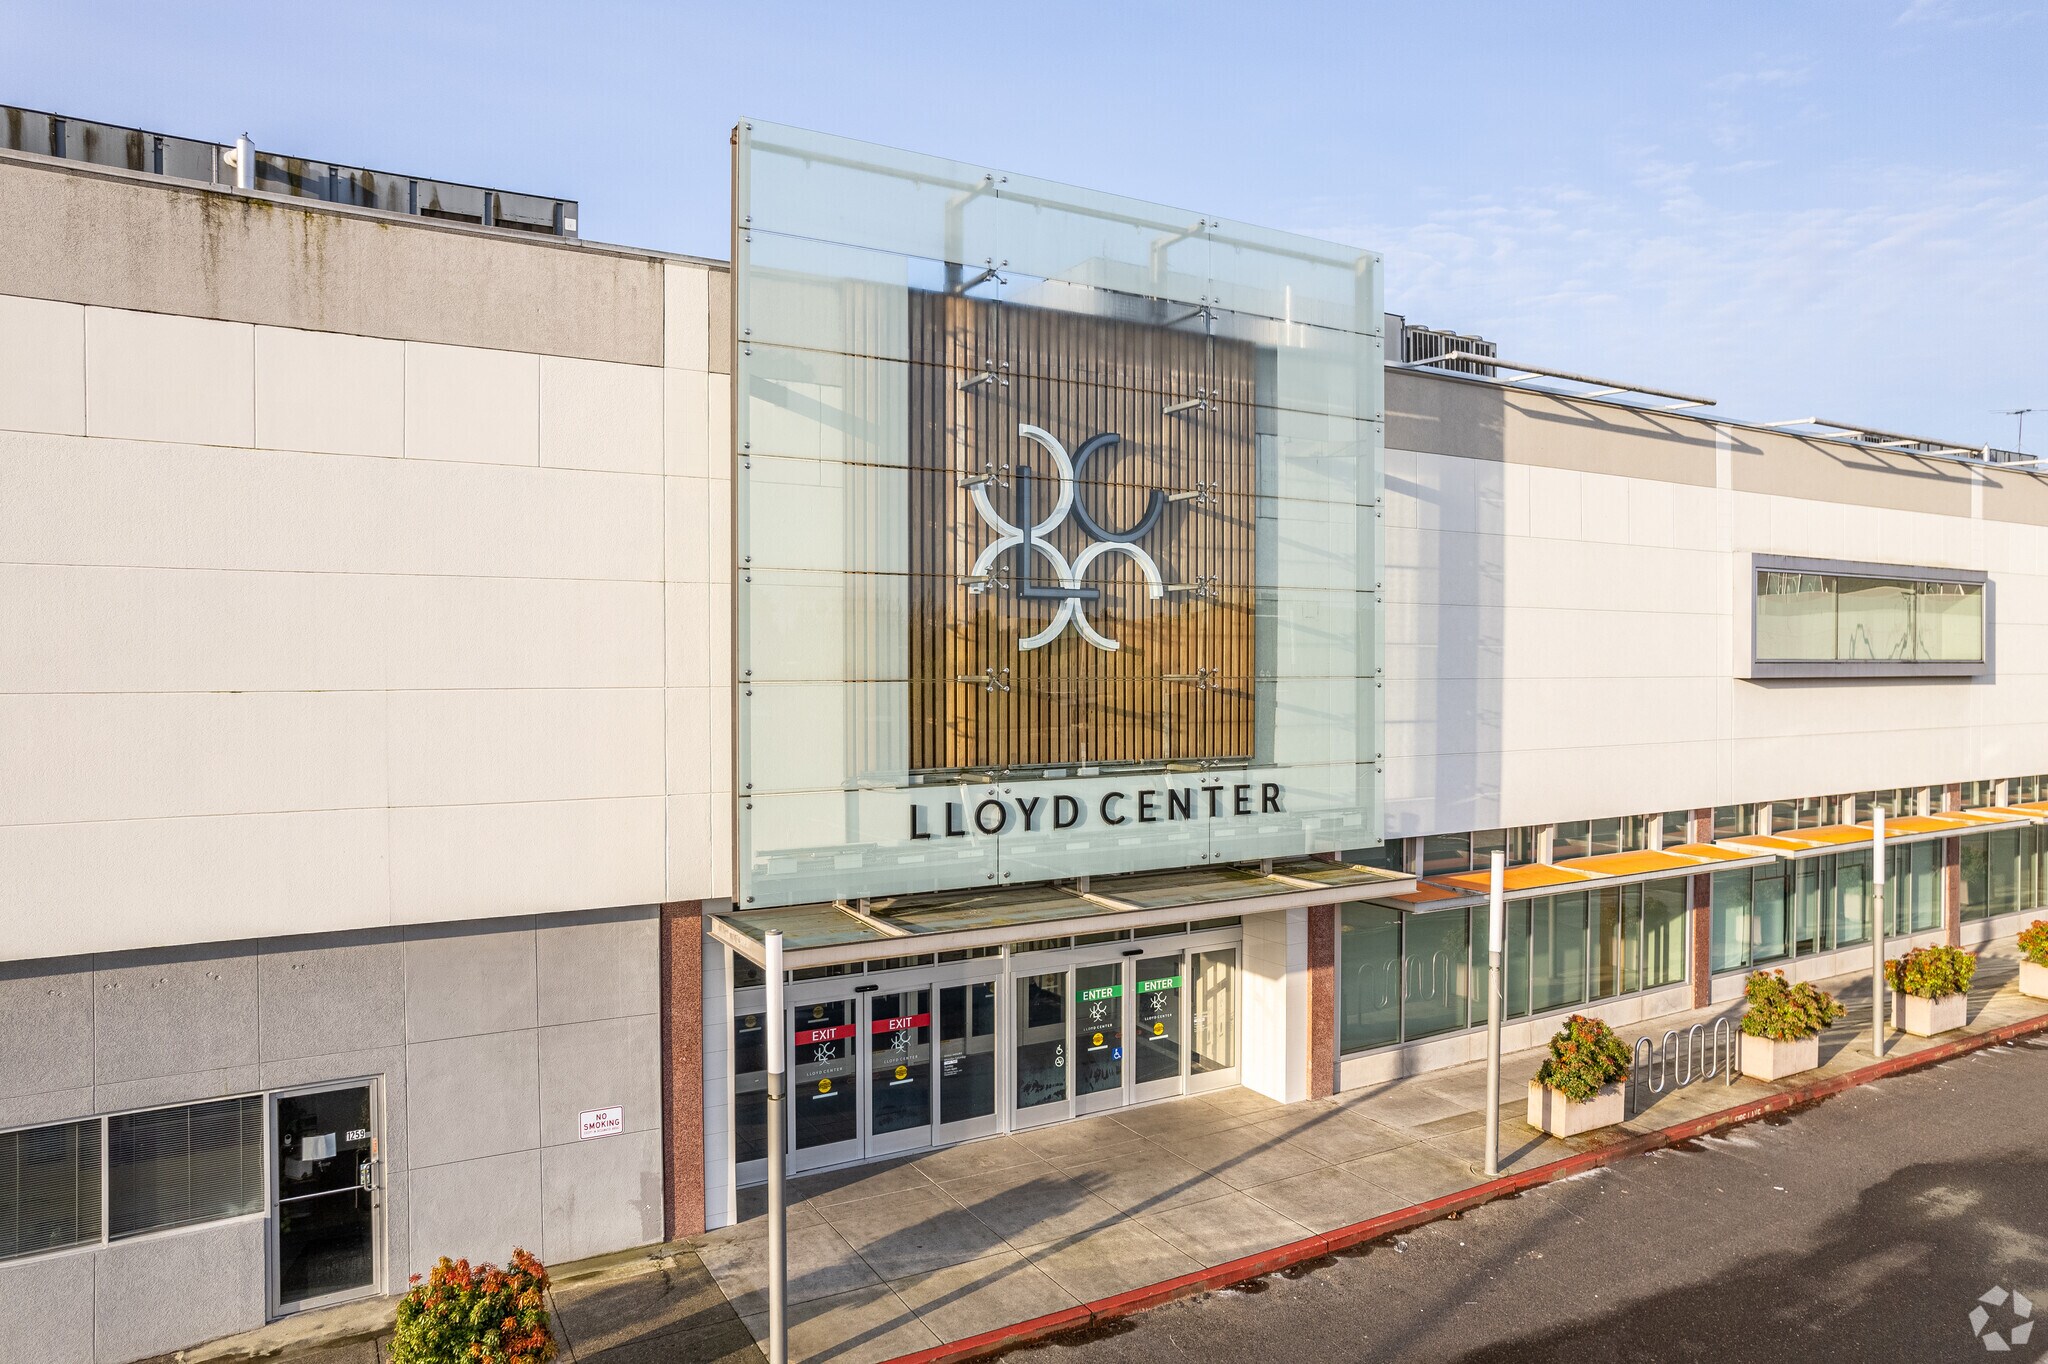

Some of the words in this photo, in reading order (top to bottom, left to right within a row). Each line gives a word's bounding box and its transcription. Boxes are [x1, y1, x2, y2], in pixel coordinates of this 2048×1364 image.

[910, 795, 1079, 841] LLOYD
[1100, 782, 1281, 825] CENTER
[1144, 978, 1173, 991] ENTER
[1083, 987, 1113, 1000] ENTER
[889, 1016, 913, 1030] EXIT
[812, 1027, 837, 1042] EXIT
[595, 1112, 607, 1121] NO
[583, 1118, 620, 1131] SMOKING
[346, 1129, 365, 1141] 1259
